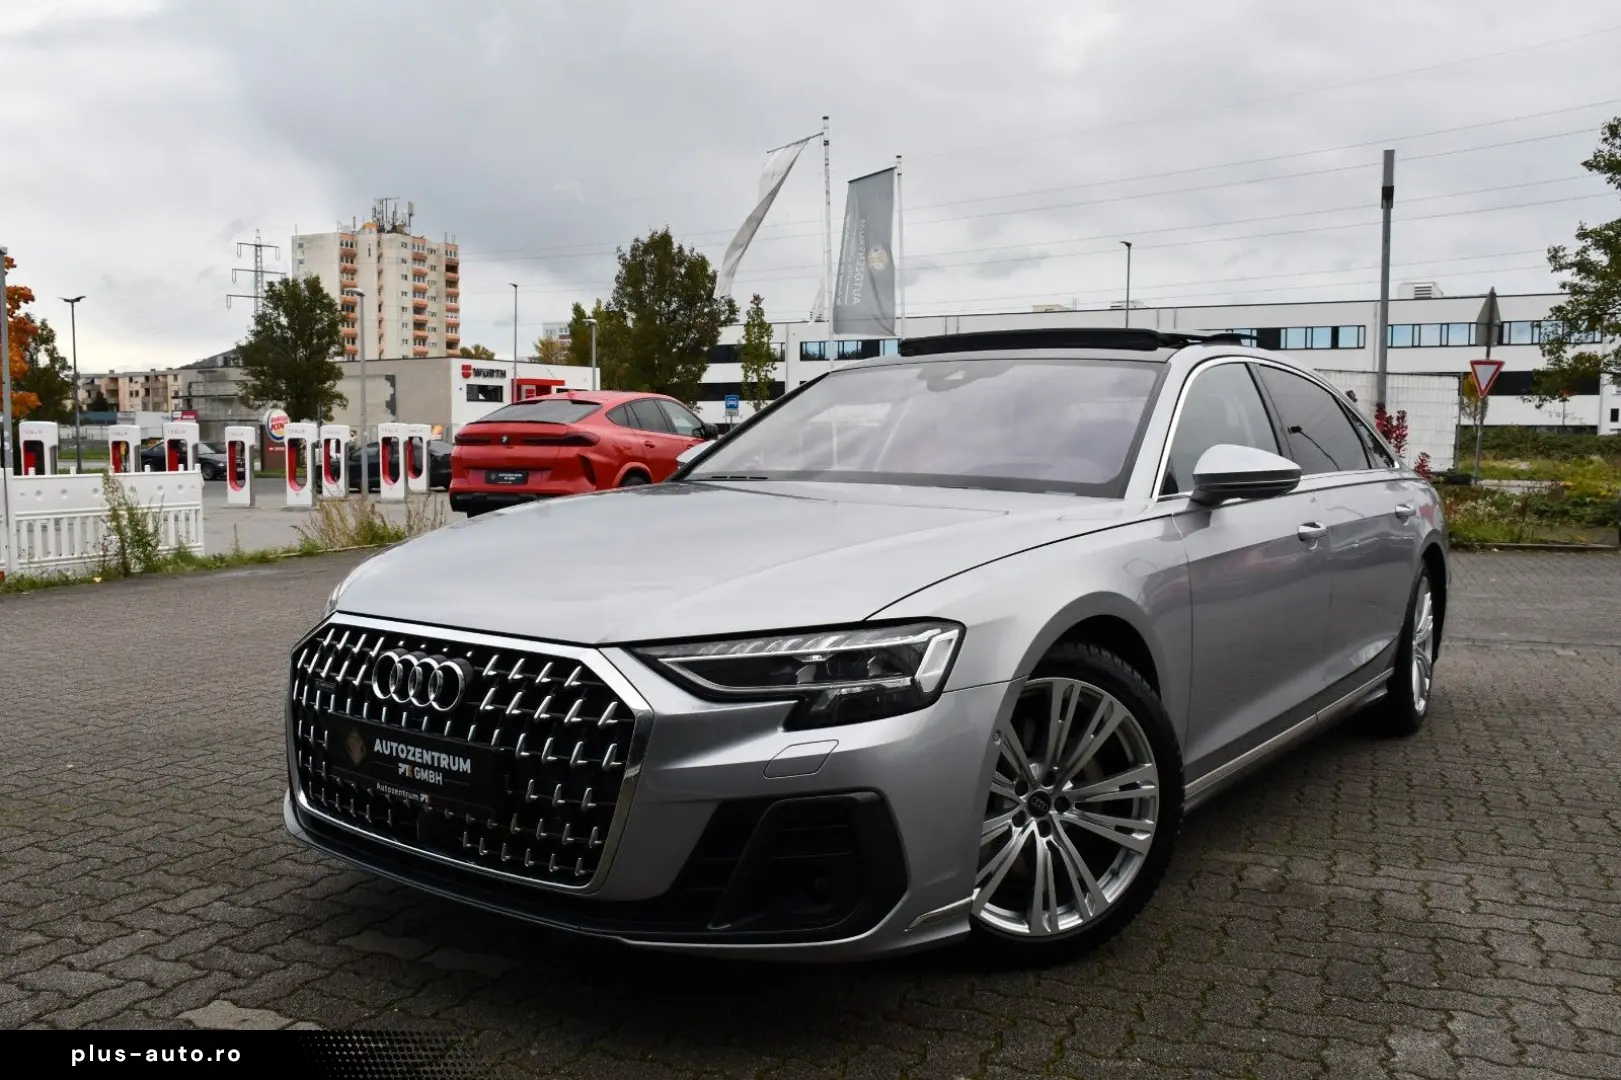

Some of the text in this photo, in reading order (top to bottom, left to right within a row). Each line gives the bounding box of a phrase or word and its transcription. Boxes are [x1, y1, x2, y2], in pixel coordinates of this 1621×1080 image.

[374, 738, 471, 774] AUTOZENTRUM
[414, 766, 443, 786] GMBH
[376, 782, 419, 801] Autozentrum
